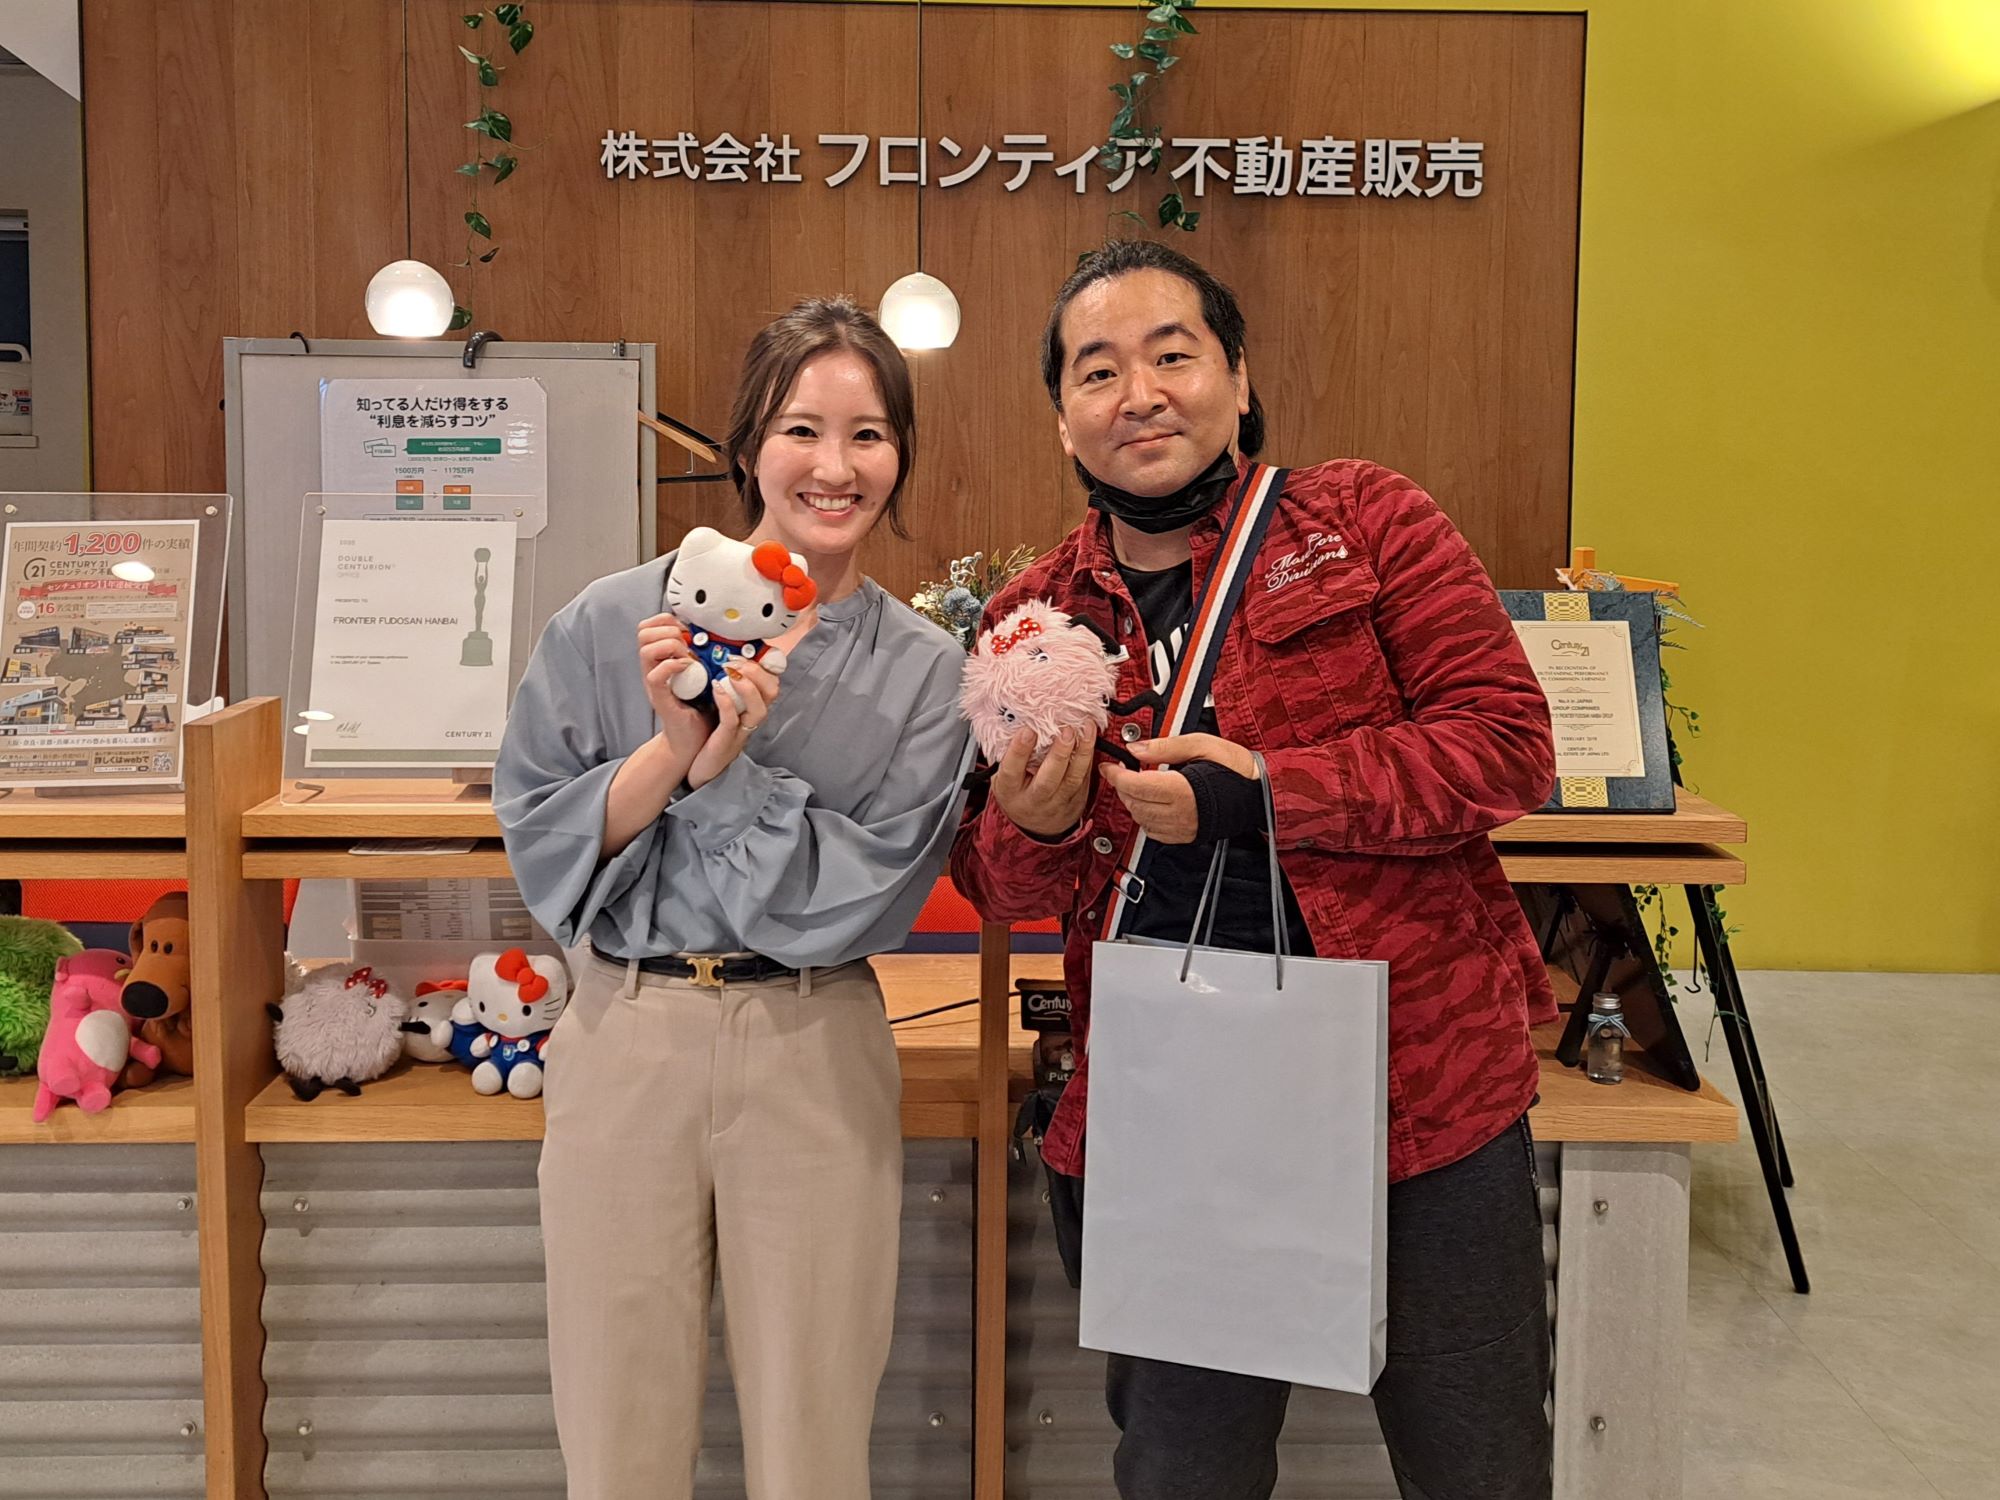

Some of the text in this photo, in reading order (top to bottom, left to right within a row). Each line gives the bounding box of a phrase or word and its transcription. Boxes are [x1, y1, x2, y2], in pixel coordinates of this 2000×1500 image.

[600, 129, 1485, 199] 株式会社 フロンティア不動産販売
[356, 397, 509, 412] 知ってる人だけ得をする
[50, 561, 97, 569] CENTURY
[333, 616, 458, 625] FRONTIER FUDOSAN HANBAI
[1551, 639, 1581, 651] Century
